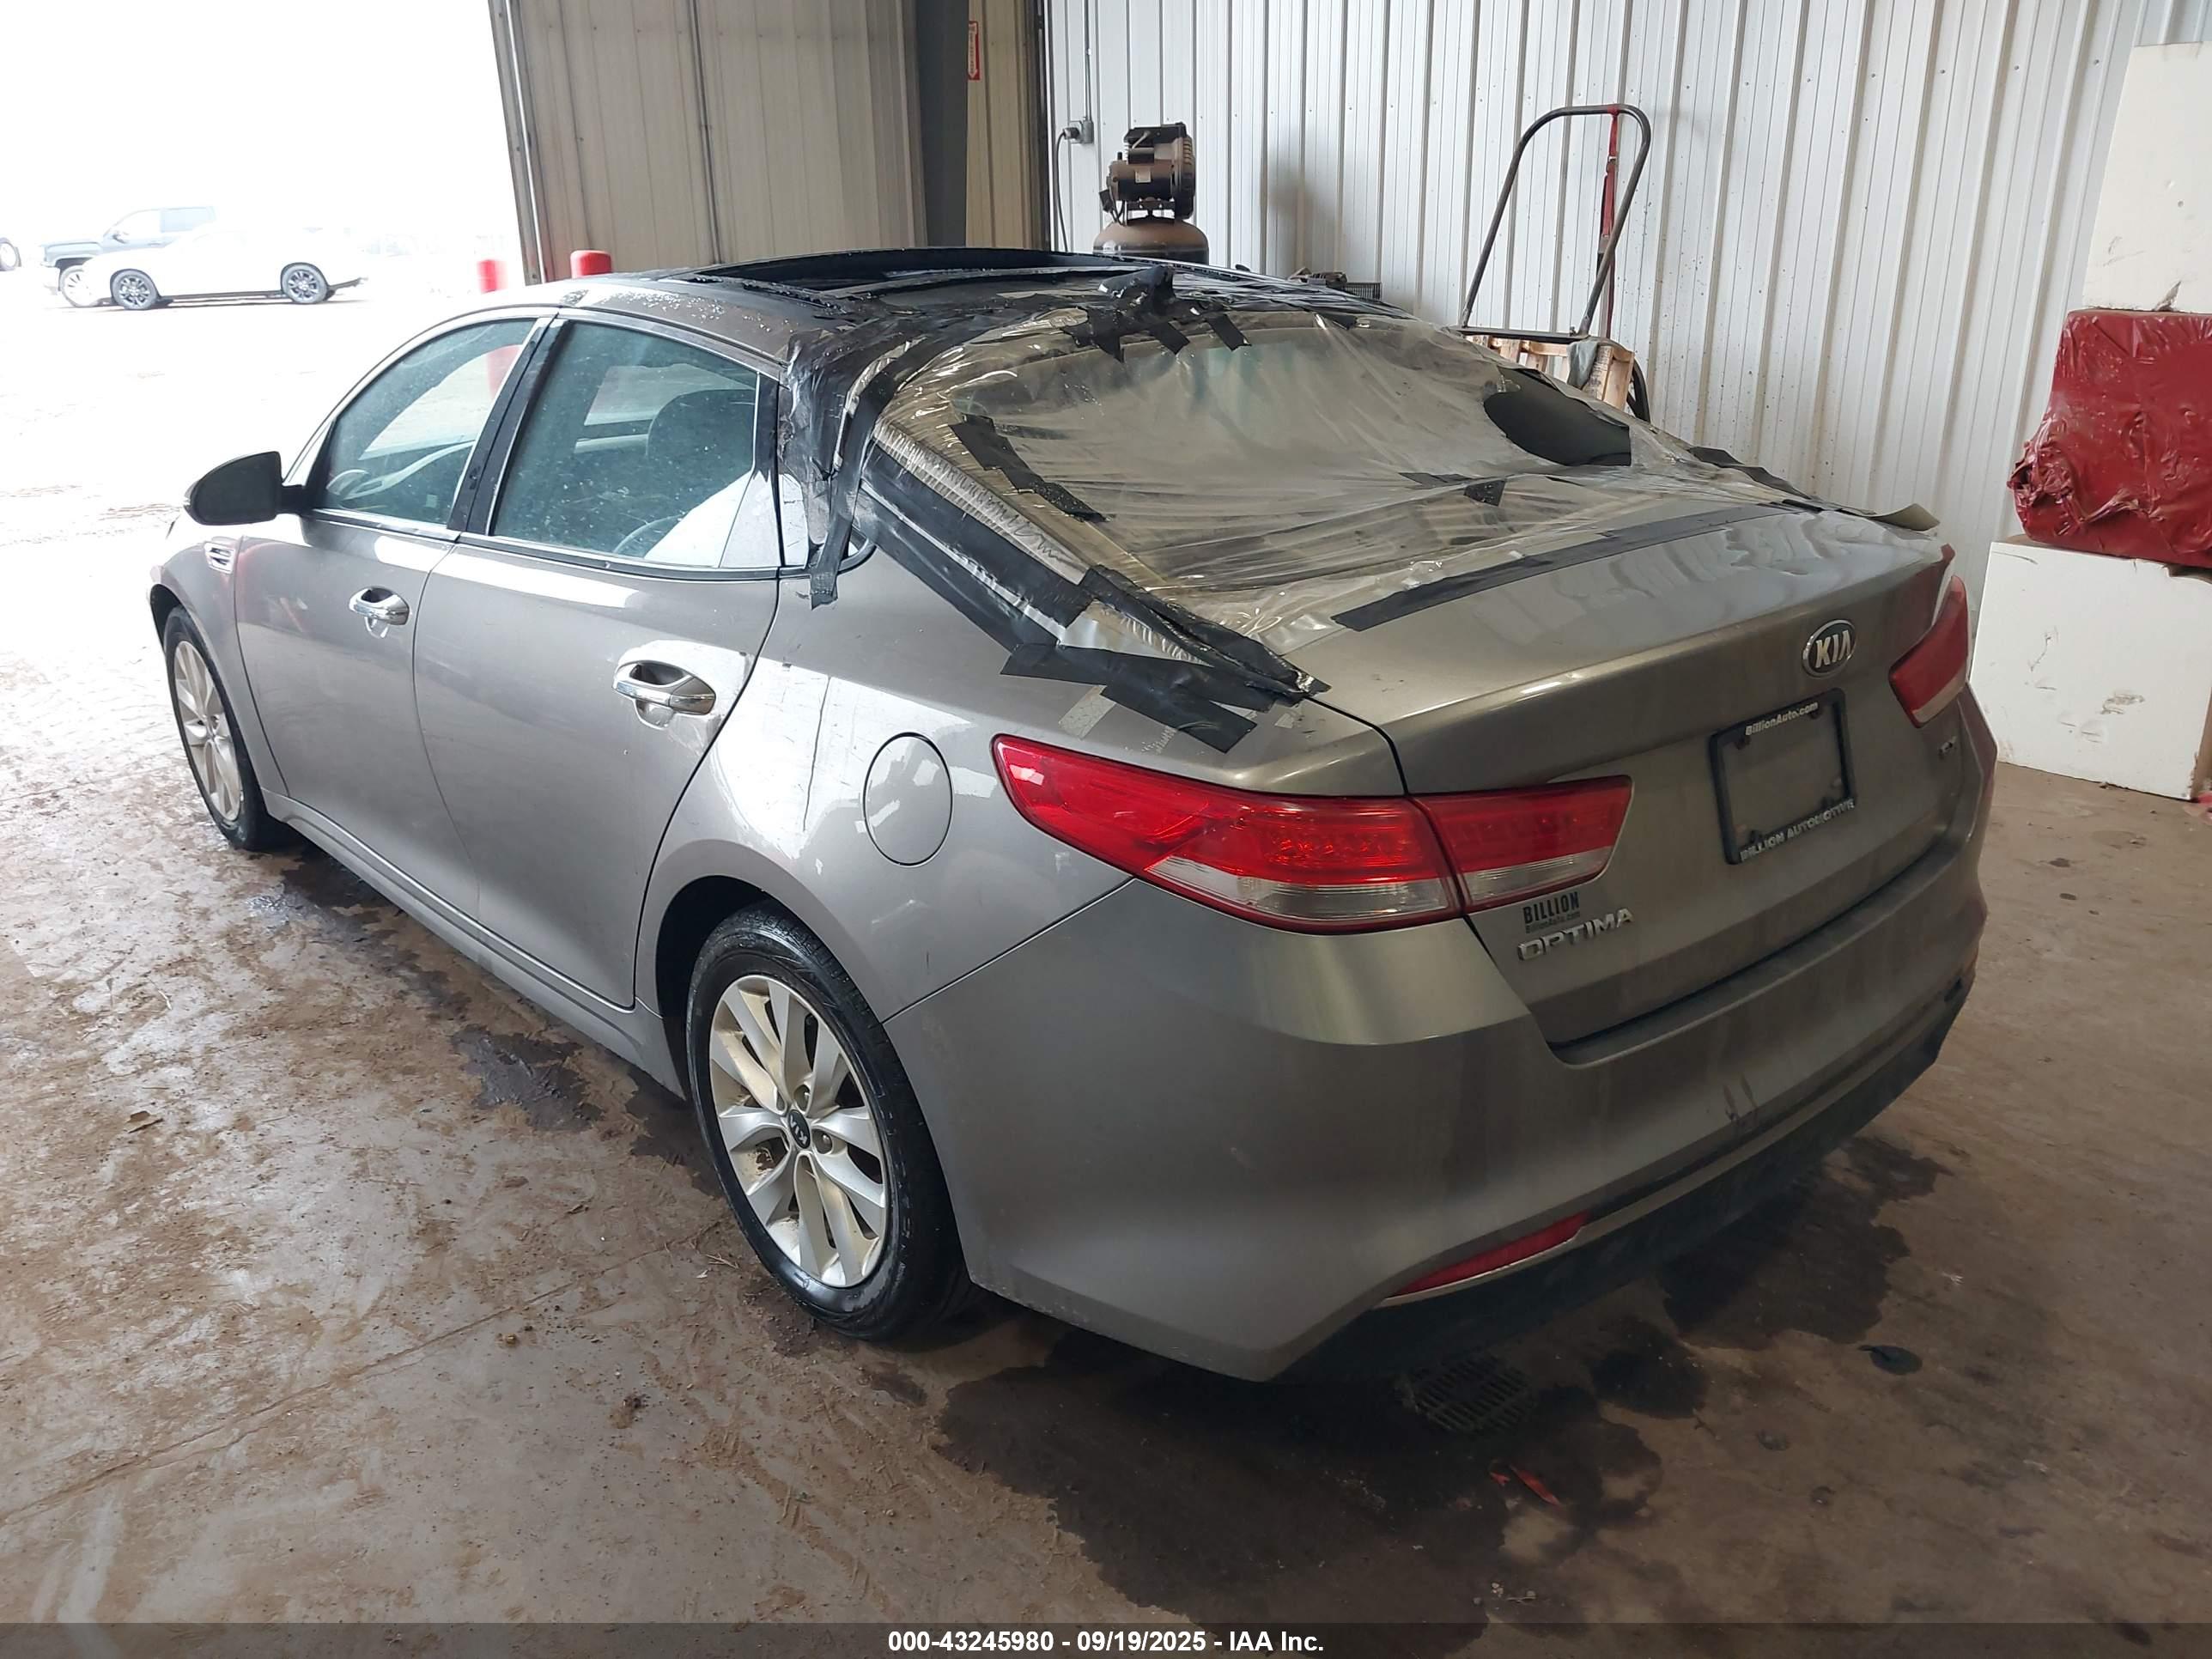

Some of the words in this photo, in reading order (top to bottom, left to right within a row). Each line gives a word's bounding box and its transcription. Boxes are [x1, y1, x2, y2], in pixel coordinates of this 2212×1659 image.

[1815, 629, 1850, 668] KIA
[1745, 702, 1819, 736] BillionAuto.com
[1523, 891, 1580, 925] BILLION
[1517, 908, 1635, 961] OPTIMA
